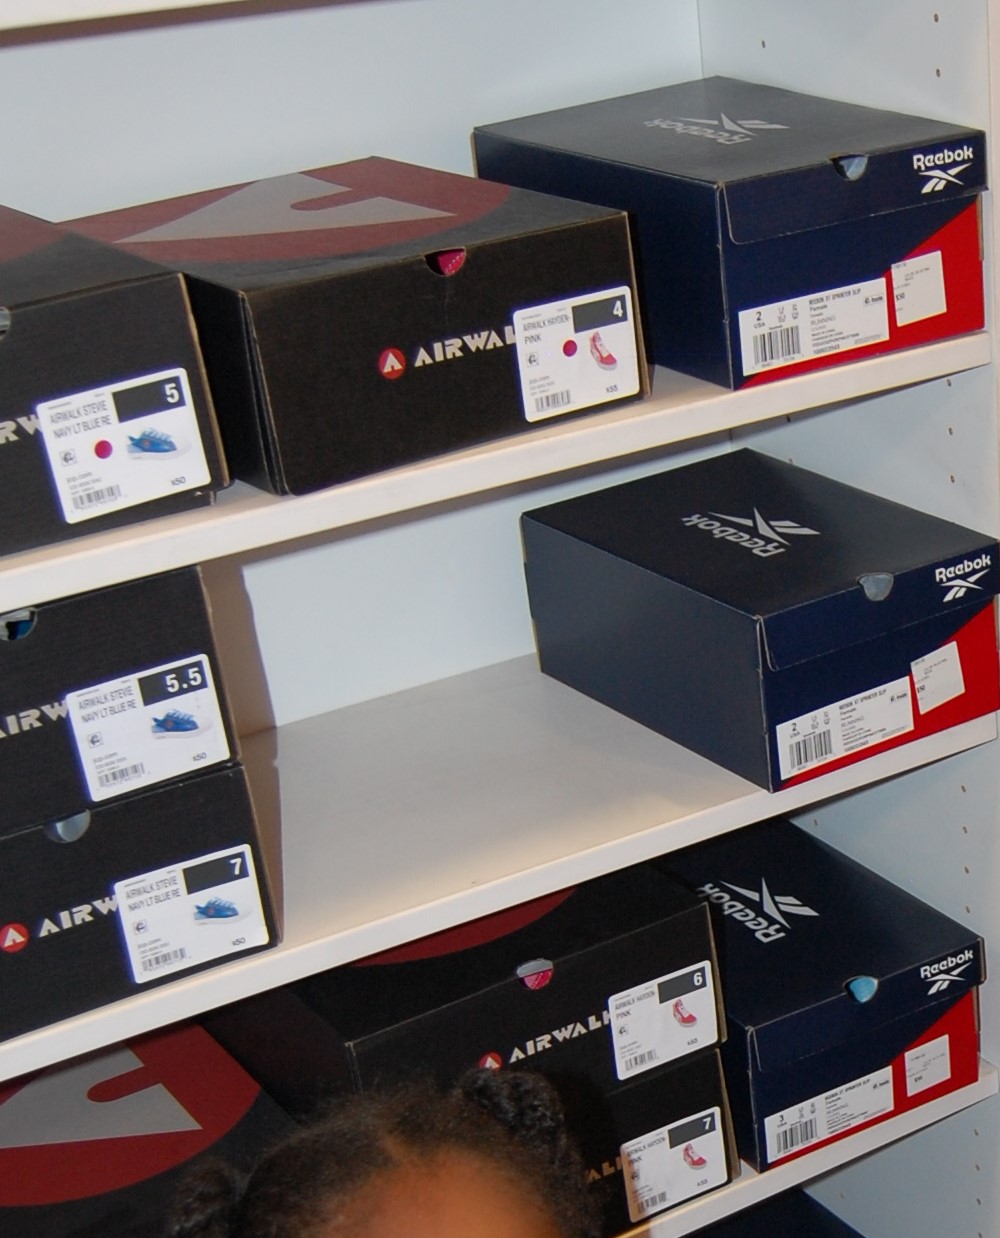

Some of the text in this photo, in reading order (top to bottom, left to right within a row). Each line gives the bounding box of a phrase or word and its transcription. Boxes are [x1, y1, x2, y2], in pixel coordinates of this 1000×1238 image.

[644, 117, 752, 145] Reebok
[913, 145, 974, 171] Reebok
[613, 301, 623, 318] 4
[756, 311, 762, 321] 2
[524, 334, 542, 345] PINK
[164, 383, 180, 404] 5
[50, 406, 82, 425] AIRWALK
[82, 400, 107, 417] STEVIE
[53, 414, 112, 440] NAVY LT BLUE RE
[681, 513, 786, 557] Reebok
[935, 554, 992, 583] Reebok
[165, 667, 203, 693] 5.5
[78, 694, 109, 711] AIRWALK
[109, 686, 134, 701] STEVIE
[81, 699, 137, 724] NAVY LT BLUE RE
[792, 723, 797, 732] 2
[230, 857, 242, 875] 7
[125, 884, 156, 900] AIRWALK
[156, 876, 178, 892] STEVIE
[128, 899, 146, 912] NAVY
[153, 892, 171, 905] BLUE
[171, 888, 180, 898] RE
[697, 883, 787, 943] Reebok
[920, 949, 974, 980] Reebok
[693, 973, 703, 987] 6
[616, 1009, 631, 1020] PINK
[702, 1117, 712, 1130] 7
